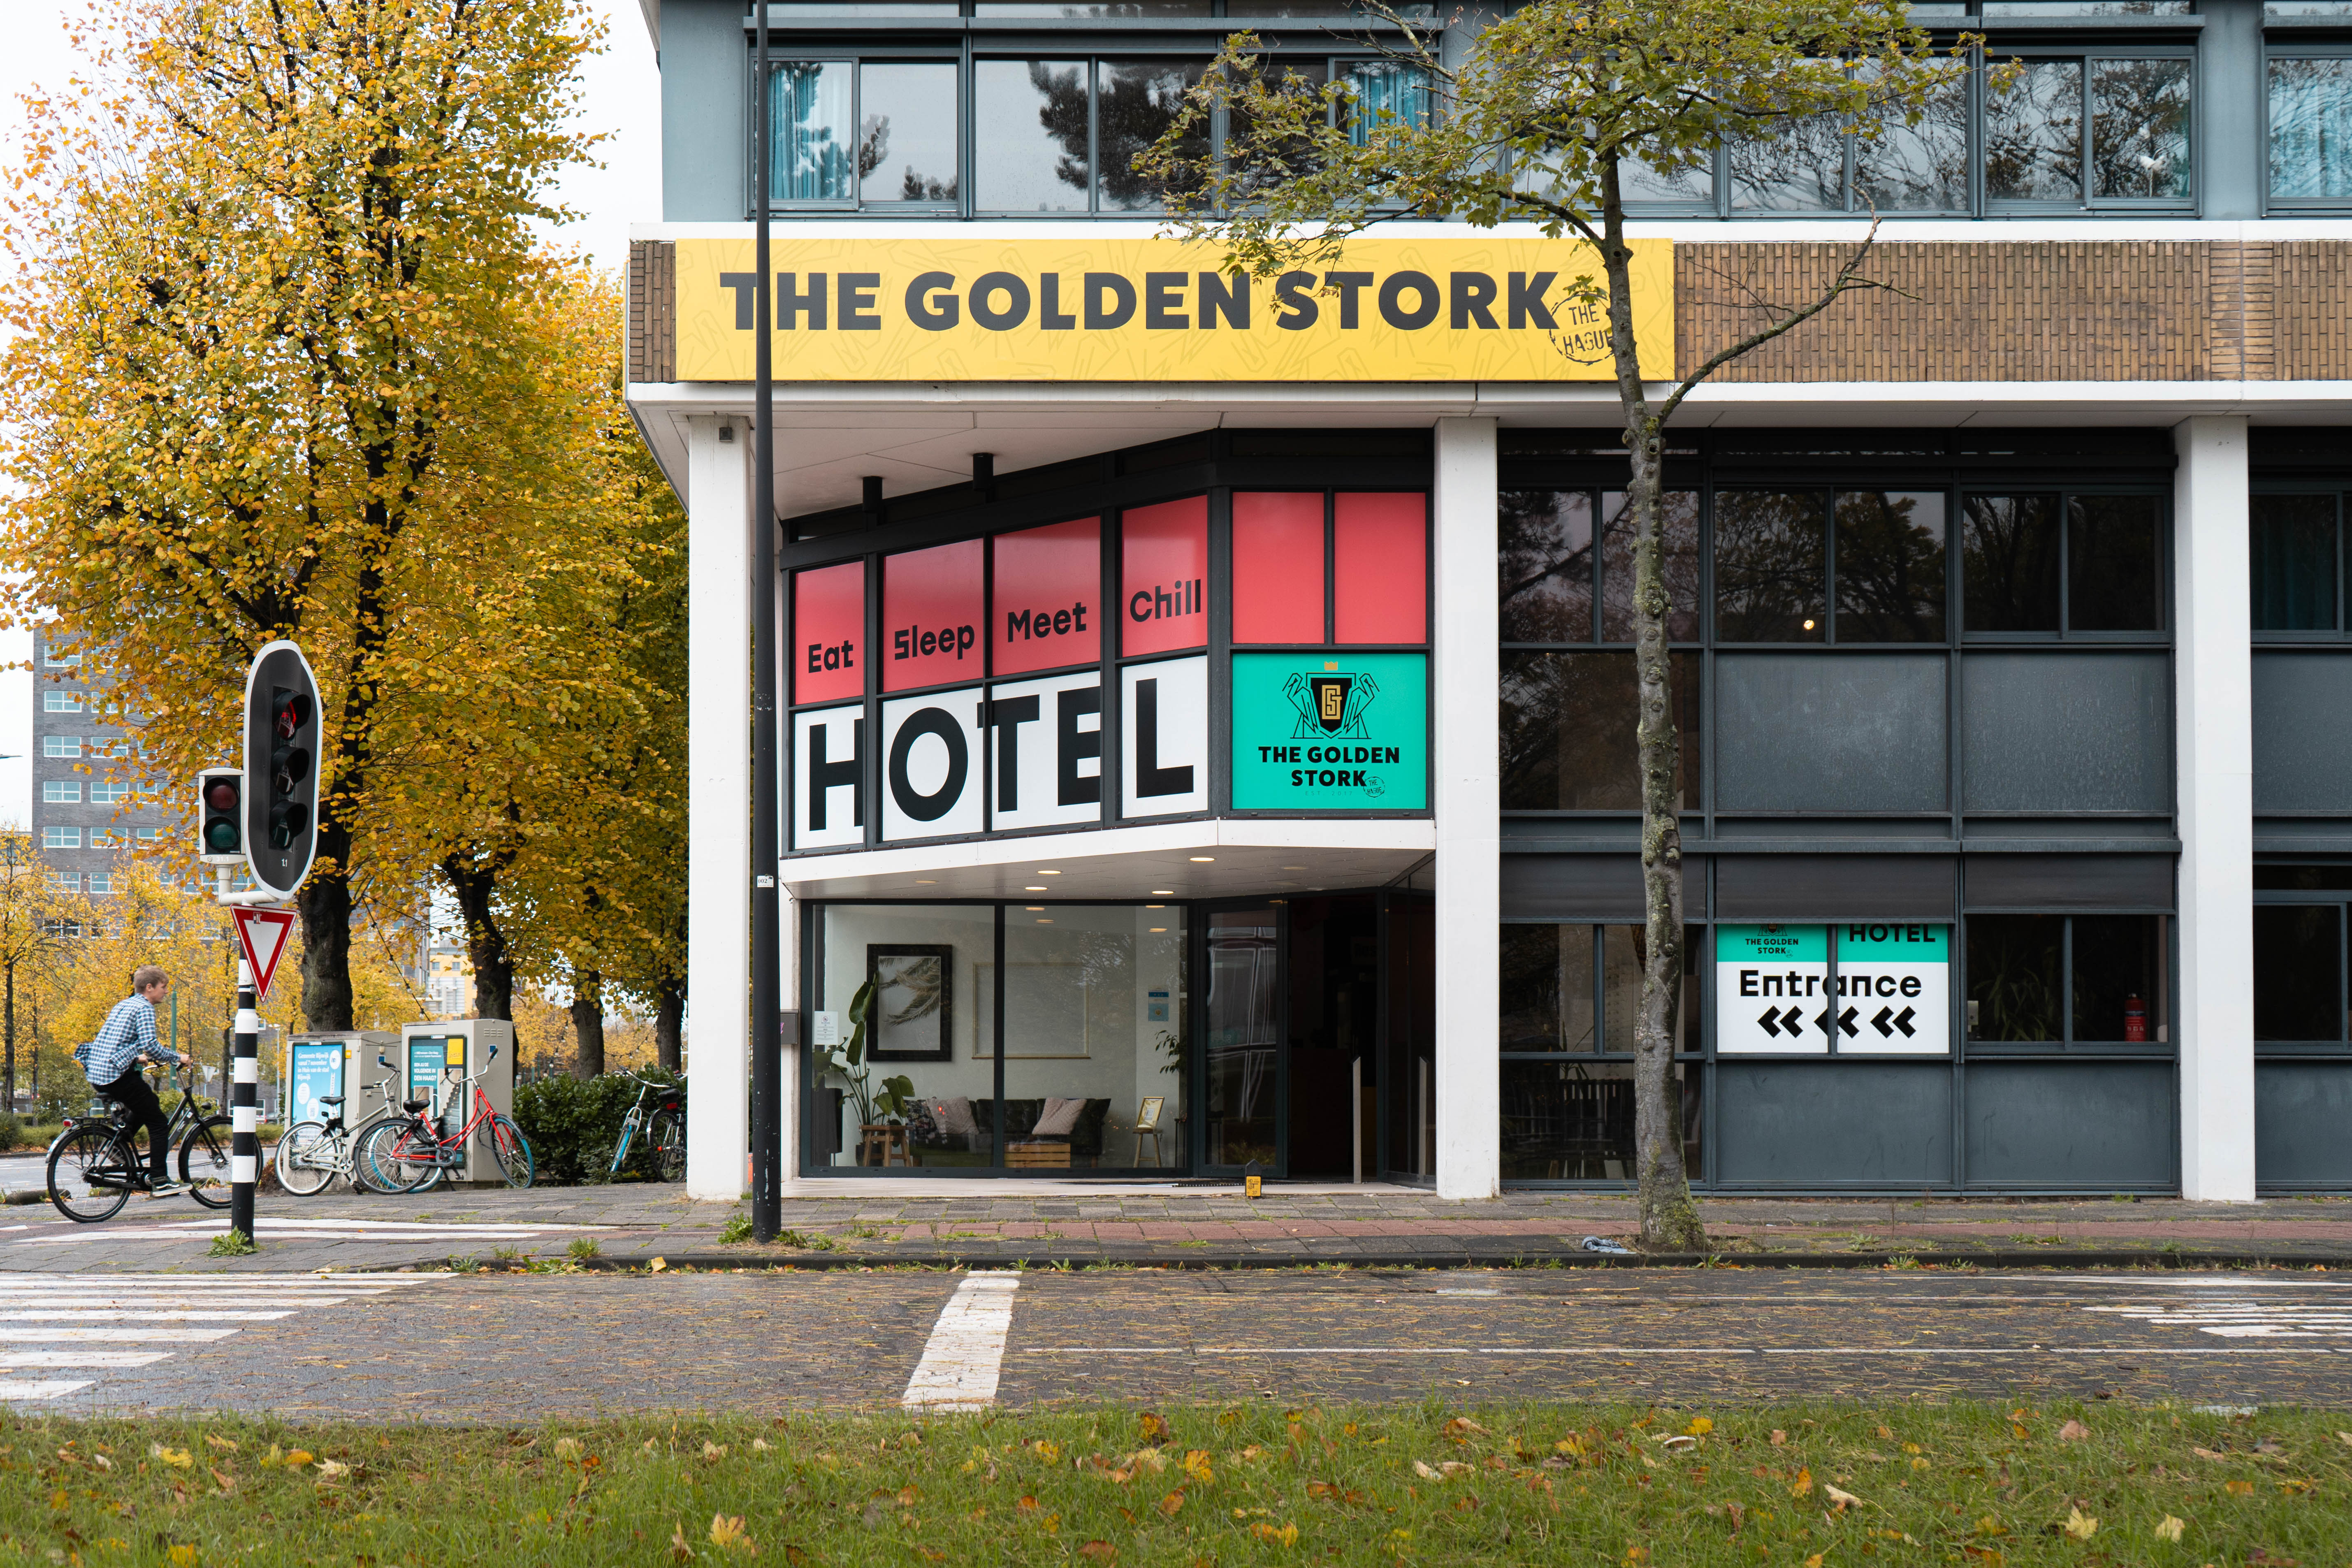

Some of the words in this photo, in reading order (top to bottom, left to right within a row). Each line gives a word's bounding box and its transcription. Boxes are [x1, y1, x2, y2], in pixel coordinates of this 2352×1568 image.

[719, 271, 881, 330] THE
[905, 271, 1250, 331] GOLDEN
[1275, 270, 1560, 330] STORK
[1568, 303, 1600, 325] THE
[808, 639, 854, 674] Eat
[894, 624, 974, 660] Sleep
[1007, 601, 1087, 643] Meet
[1129, 578, 1202, 622] Chill
[809, 677, 1194, 832] HOTEL
[1258, 746, 1301, 763] THE
[1307, 746, 1400, 763] GOLDEN
[1291, 769, 1368, 787] STORK
[1367, 786, 1382, 795] HAGUE
[1849, 923, 1936, 942] HOTEL
[1740, 970, 1922, 998] Entrance
